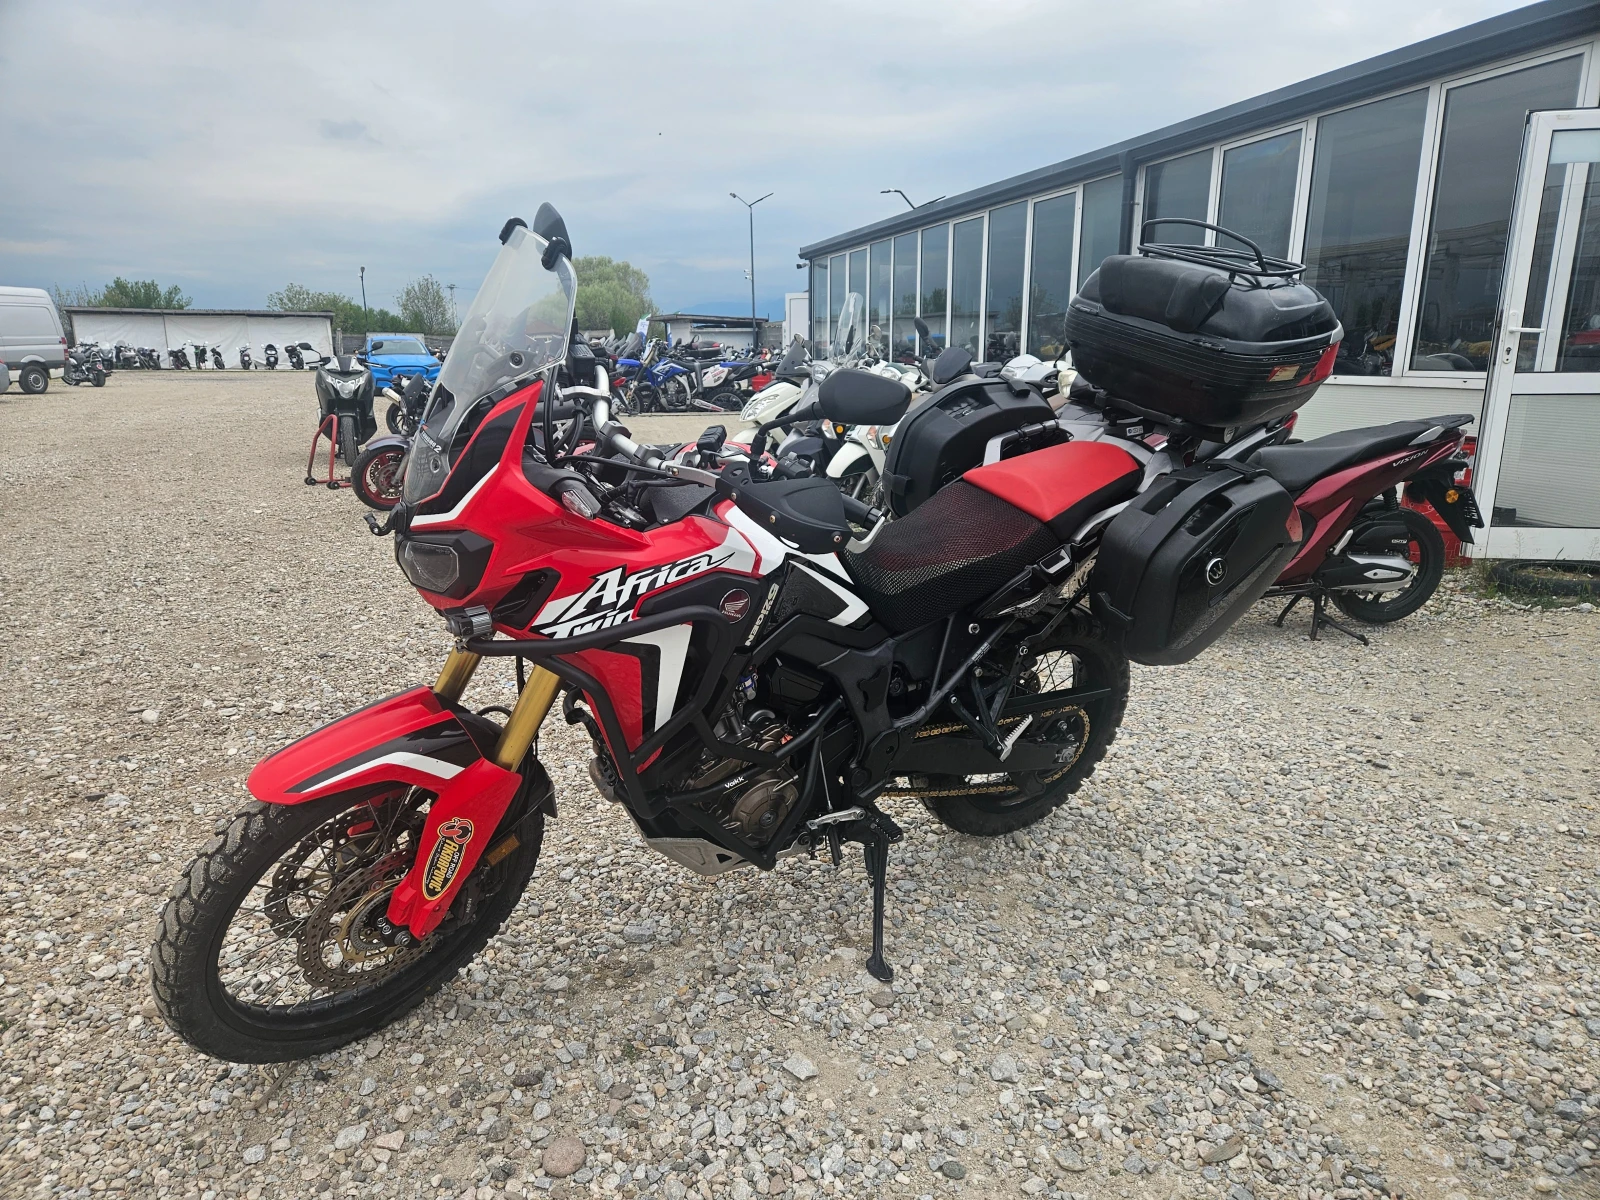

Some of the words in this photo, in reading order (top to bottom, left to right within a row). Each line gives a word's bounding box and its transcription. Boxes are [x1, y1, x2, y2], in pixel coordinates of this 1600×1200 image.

[1392, 449, 1429, 467] VISION
[556, 552, 736, 623] Africa
[539, 608, 634, 639] Twin
[446, 862, 456, 879] ROAD
